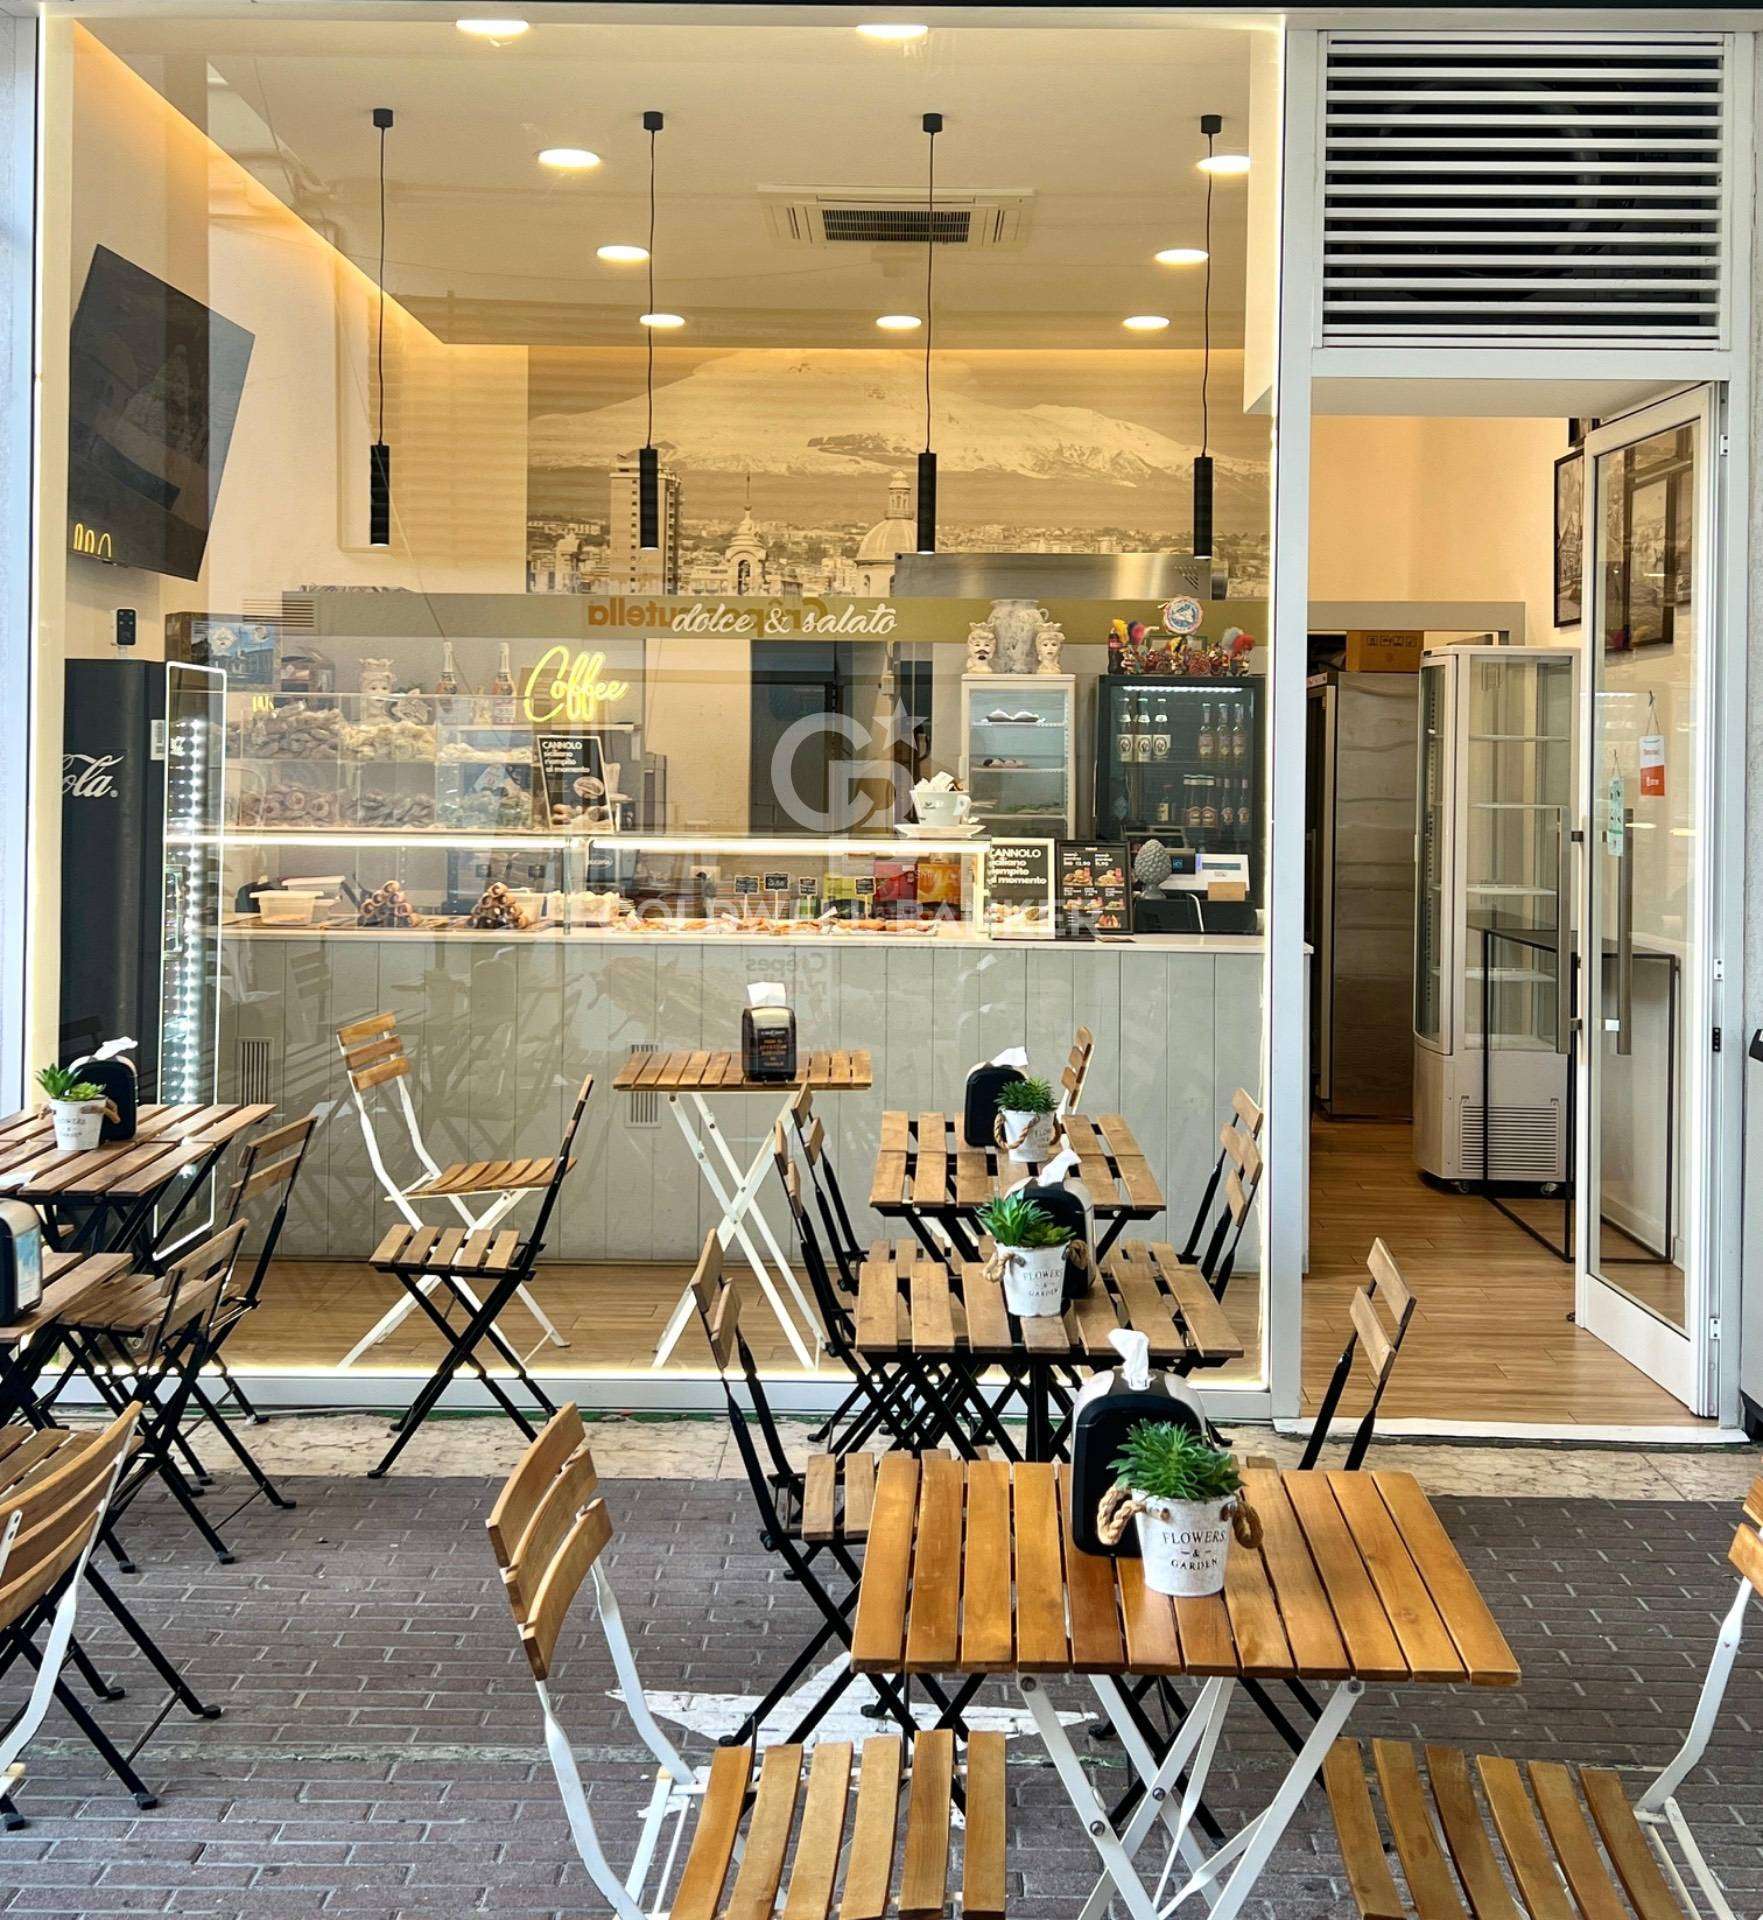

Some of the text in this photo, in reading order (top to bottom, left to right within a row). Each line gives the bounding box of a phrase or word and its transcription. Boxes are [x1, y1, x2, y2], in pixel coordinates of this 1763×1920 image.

[672, 602, 897, 634] dolce & salato
[523, 645, 630, 722] Coffee
[541, 741, 583, 750] CANNOLO
[998, 876, 1047, 884] momento
[1162, 1529, 1226, 1544] FLOWERS
[1171, 1558, 1218, 1570] GARDEN
